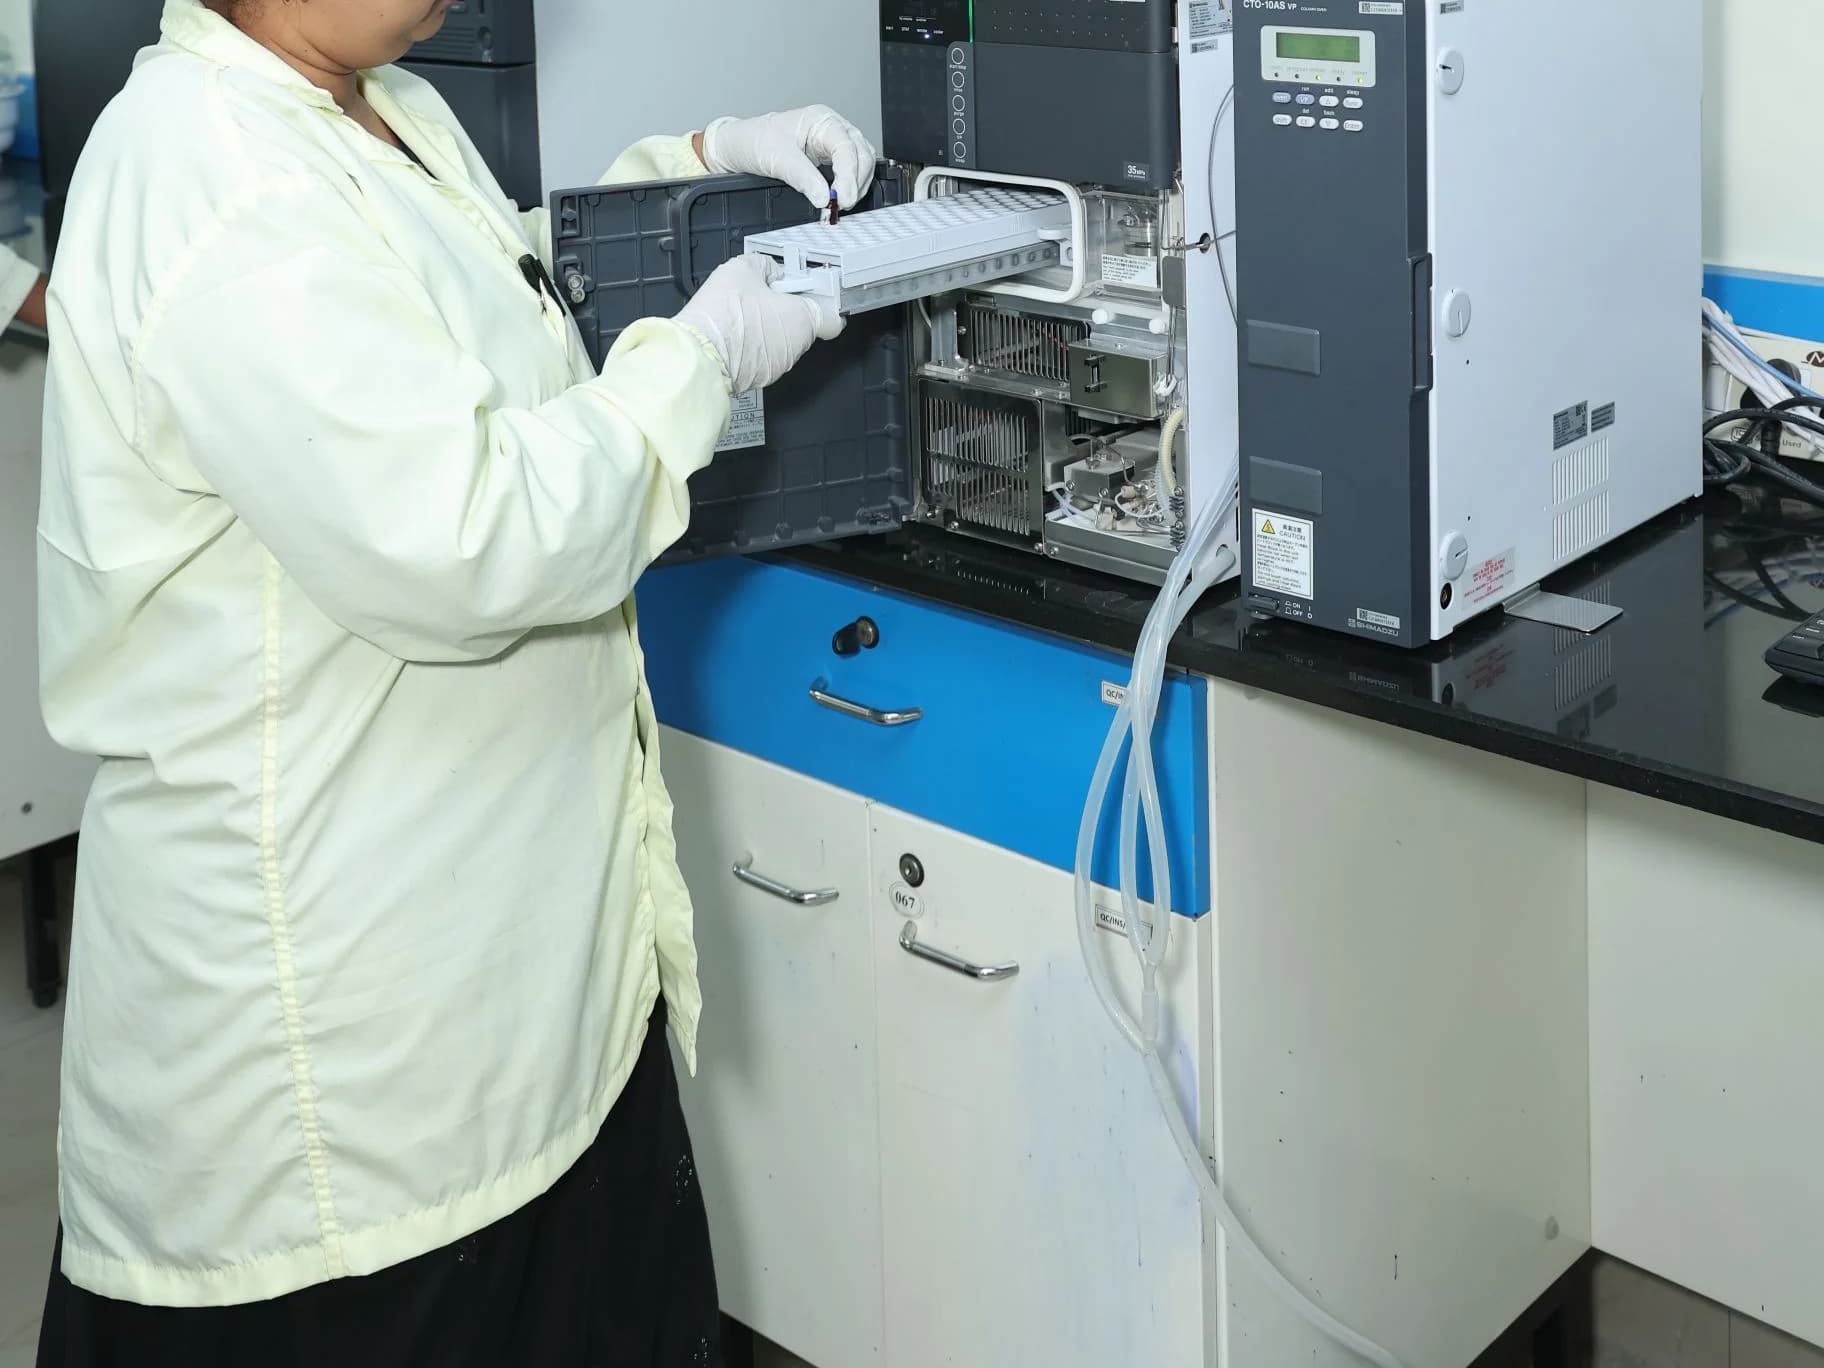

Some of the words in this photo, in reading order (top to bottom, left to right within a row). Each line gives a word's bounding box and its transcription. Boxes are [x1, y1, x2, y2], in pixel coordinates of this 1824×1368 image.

[1243, 0, 1286, 10] CTO-10AS
[1287, 3, 1297, 11] VP
[1279, 530, 1306, 541] CAUTION
[1292, 609, 1303, 617] OFF
[1356, 621, 1399, 637] SHIMADZU
[1106, 688, 1124, 700] QC/IN
[895, 890, 915, 909] 067
[1100, 912, 1126, 929] QC/INS/
